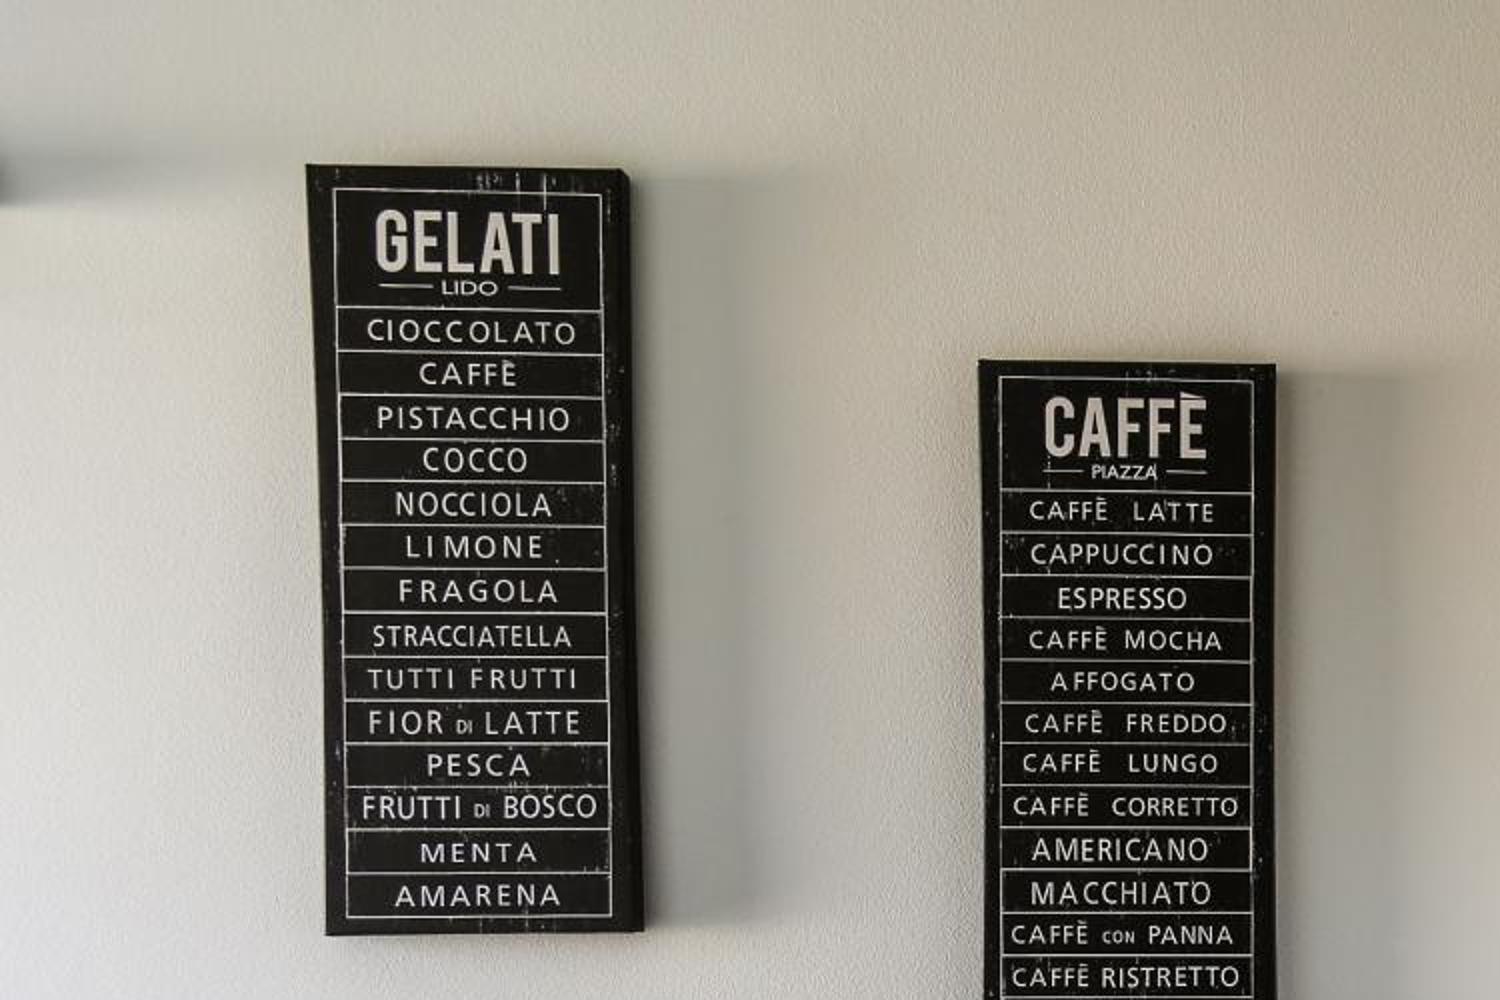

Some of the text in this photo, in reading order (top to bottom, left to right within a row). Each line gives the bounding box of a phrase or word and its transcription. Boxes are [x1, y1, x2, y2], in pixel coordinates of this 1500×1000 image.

[375, 209, 560, 275] GELATI
[441, 280, 499, 297] LIDO
[367, 318, 575, 345] CIOCCOLATO
[419, 359, 516, 387] CAFFÈ
[377, 405, 570, 432] PISTACCHIO
[1045, 391, 1207, 460] CAFFÈ
[422, 446, 527, 473] COCCO
[1091, 463, 1158, 481] PIAZZA
[395, 491, 552, 517] NOCCIOLA
[1029, 496, 1213, 523] CAFFÈ LATTE
[406, 535, 542, 559] LIMONE
[1030, 543, 1213, 566] CAPPUCCINO
[399, 579, 558, 603] FRAGOLA
[1058, 586, 1187, 610] ESPRESSO
[373, 624, 572, 648] STRACCIATELLA
[1029, 625, 1222, 651] CAFFÈ MOCHA
[367, 667, 576, 691] TUTTI FRUTTI
[1050, 671, 1195, 692] AFFOGATO
[369, 709, 580, 735] FIOR DI LATTE
[1025, 709, 1227, 734] CAFFÈ FREDDO
[427, 753, 530, 777] PESCA
[1023, 748, 1218, 774] CAFFÈ LUNGO
[363, 793, 597, 820] FRUTTI DI BOSCO
[1013, 791, 1239, 817] CAFFÈ CORRETTO
[420, 842, 537, 863] MENTA
[1031, 837, 1209, 862] AMERICANO
[394, 883, 561, 908] AMARENA
[1031, 880, 1211, 905] MACCHIATO
[1011, 919, 1233, 945] CAFFÈ CON PANNA
[1012, 963, 1239, 989] CAFFÈ RISTRETTO
